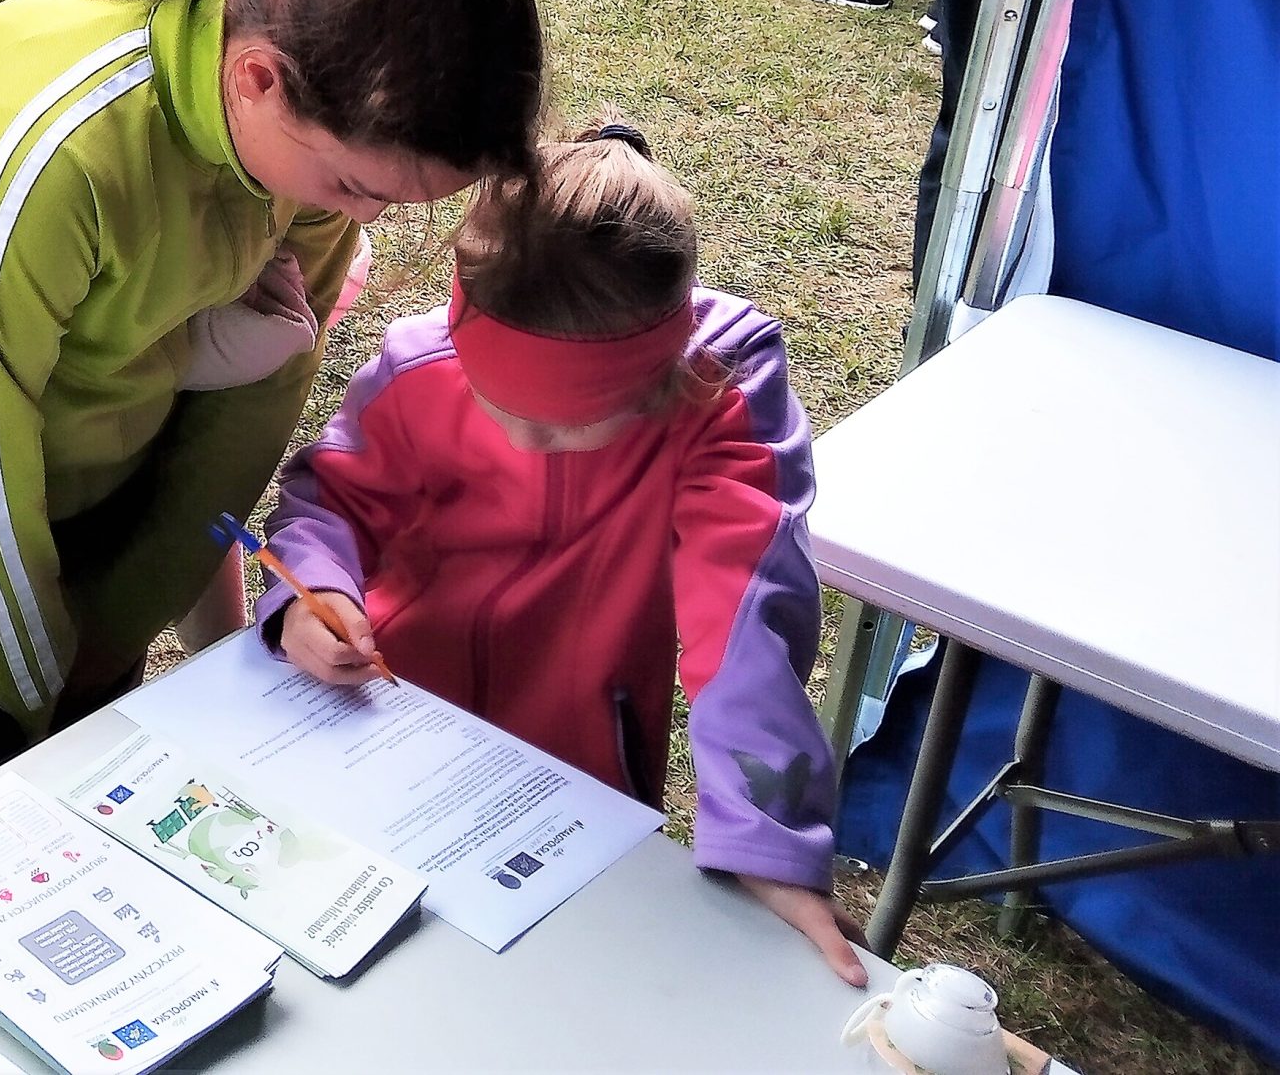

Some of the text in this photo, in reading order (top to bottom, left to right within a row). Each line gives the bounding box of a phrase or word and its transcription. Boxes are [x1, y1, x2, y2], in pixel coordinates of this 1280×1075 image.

[534, 826, 575, 856] MAŁOPOLSKA
[76, 856, 107, 876] SKUTKI
[335, 871, 371, 907] zmianach
[304, 906, 342, 939] klimatu?
[322, 877, 393, 948] Co musisz wiedzieć
[54, 945, 184, 1022] PRZYCZYNY ZMIAN KLIMATU
[152, 988, 208, 1025] MAŁOPOLSKA
